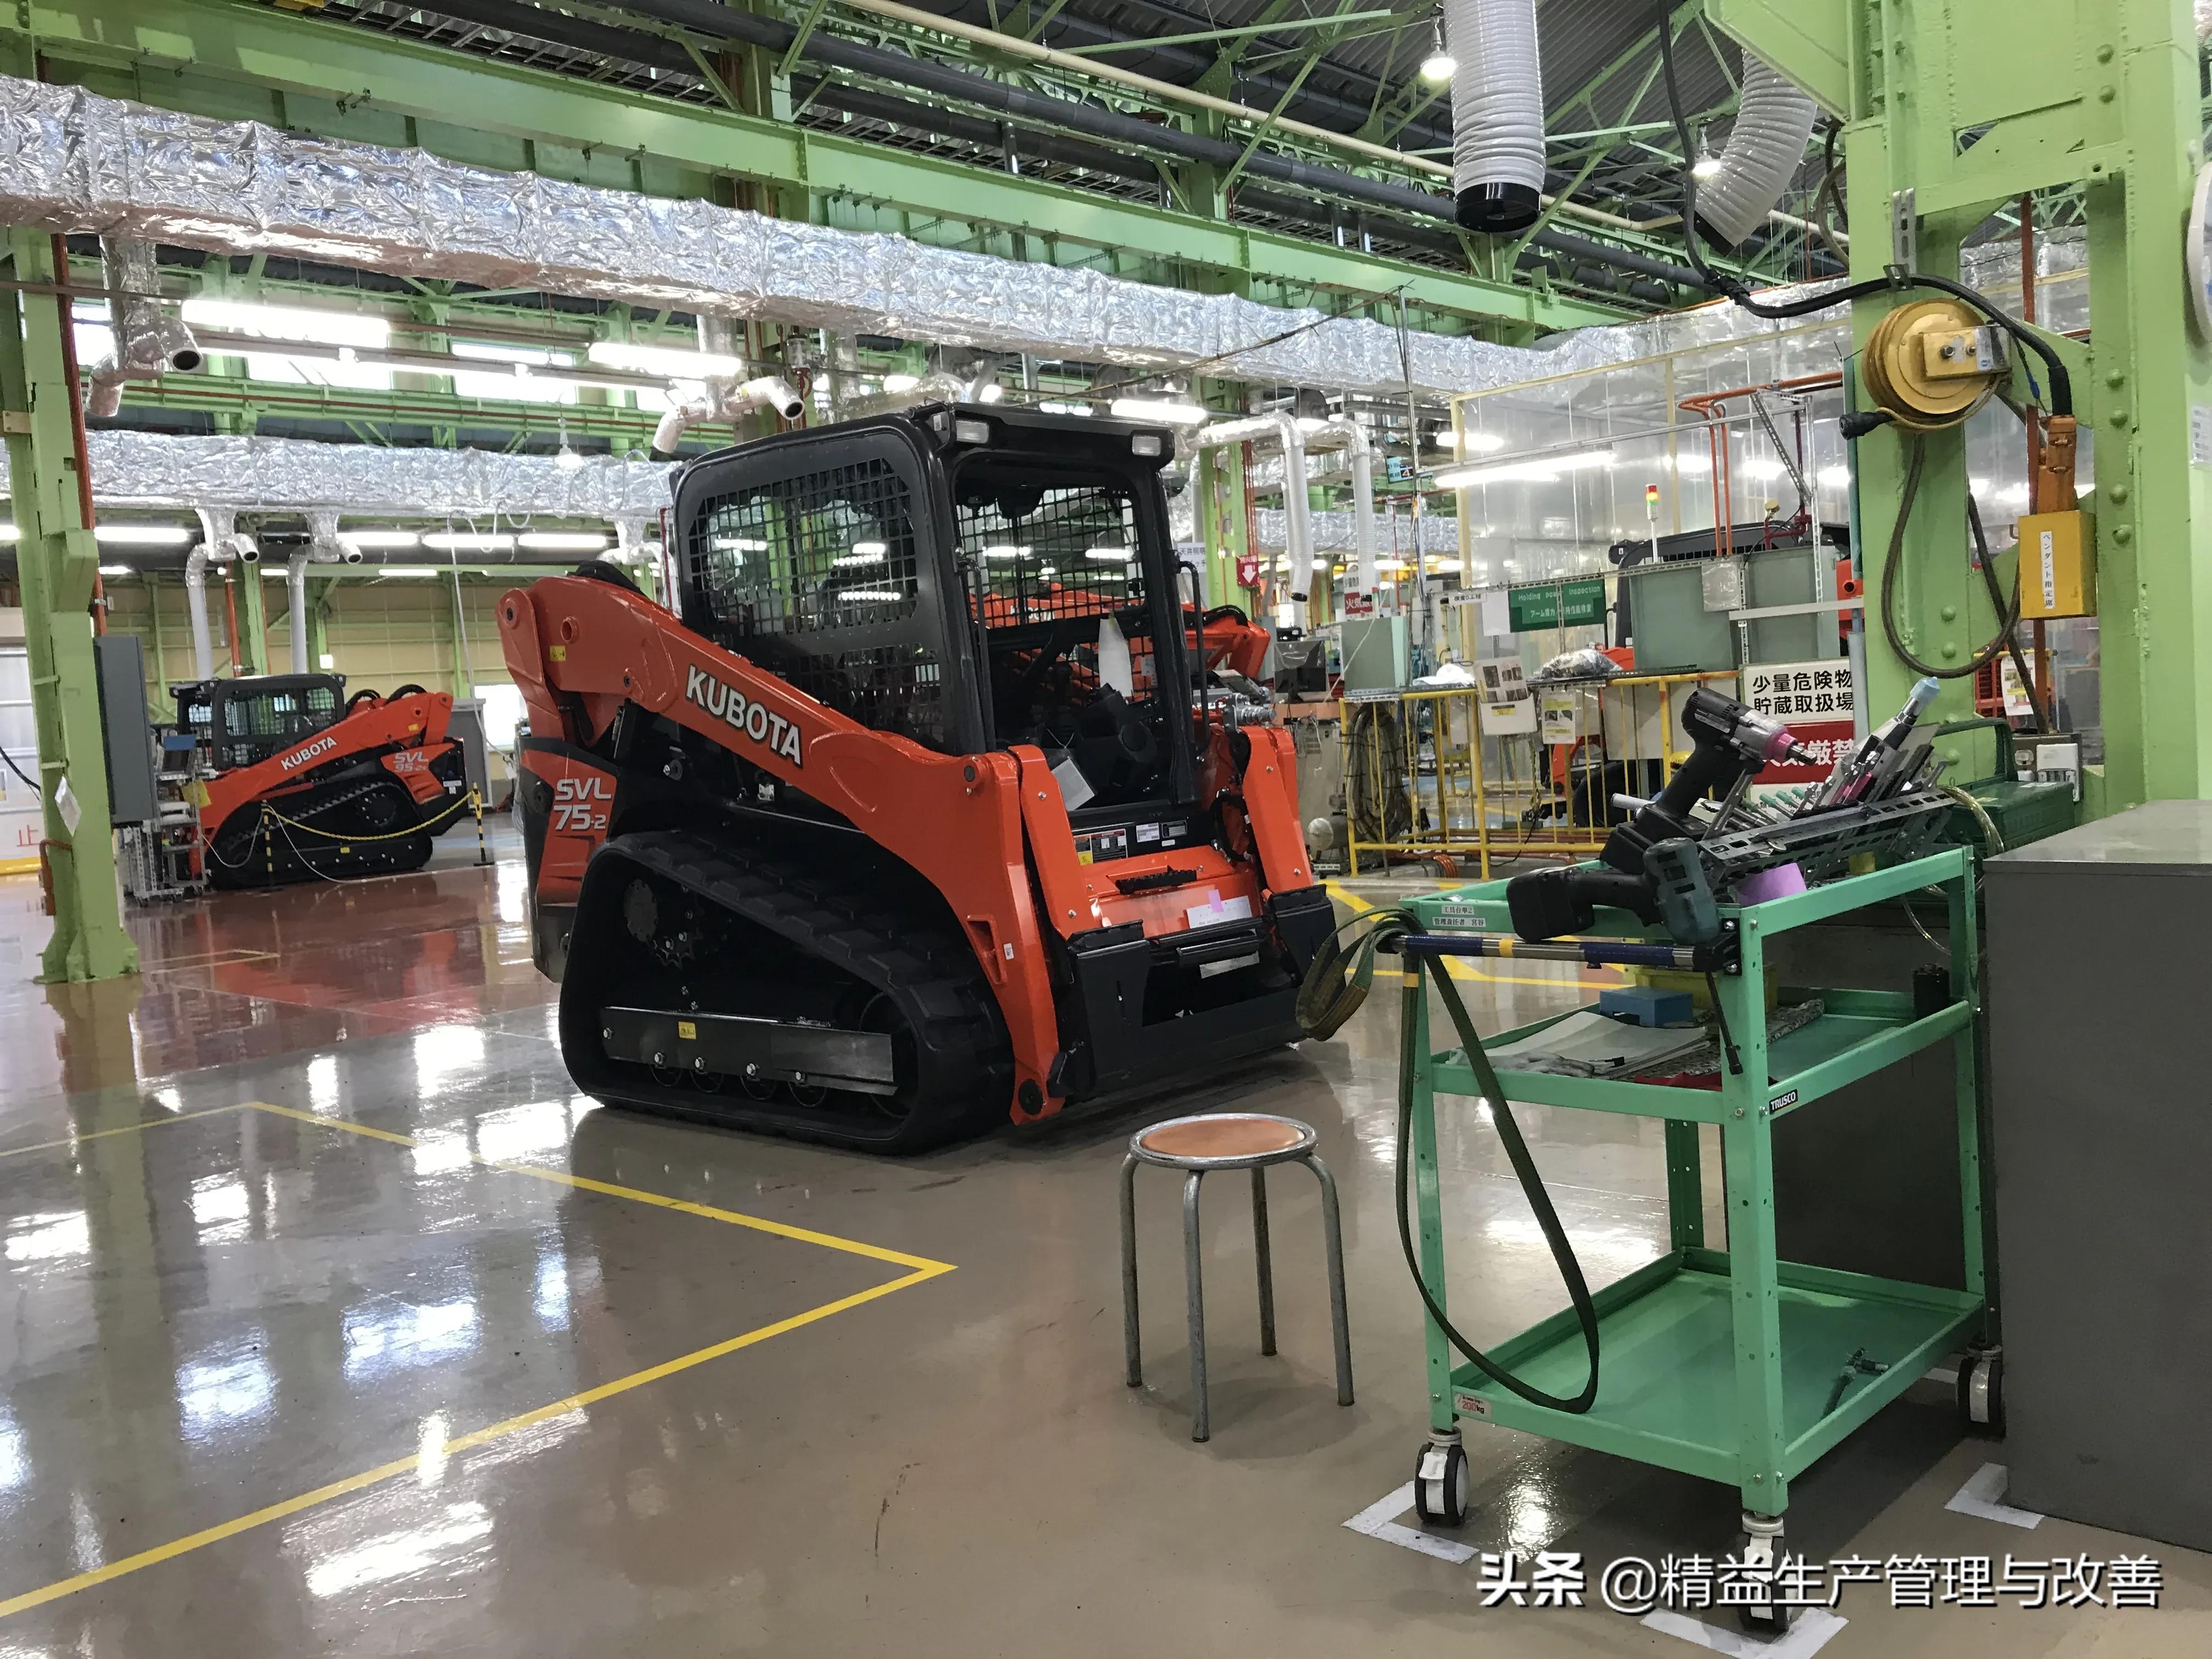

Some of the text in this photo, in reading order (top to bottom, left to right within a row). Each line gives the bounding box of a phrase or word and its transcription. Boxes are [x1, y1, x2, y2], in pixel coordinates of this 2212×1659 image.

[1518, 592, 1541, 601] Holding
[1568, 585, 1601, 595] Inspection
[1752, 669, 1852, 695] 少量危険物
[686, 663, 803, 769] KUBOTA
[1754, 692, 1853, 715] 貯蔵取扱場
[280, 736, 337, 771] KUBOTA
[393, 752, 429, 764] SVL
[1762, 738, 1855, 768] 厳禁
[554, 777, 612, 802] SVL
[554, 804, 606, 831] 75-2
[1770, 1091, 1796, 1110] TRUSCO
[1462, 1400, 1485, 1414] 200kg
